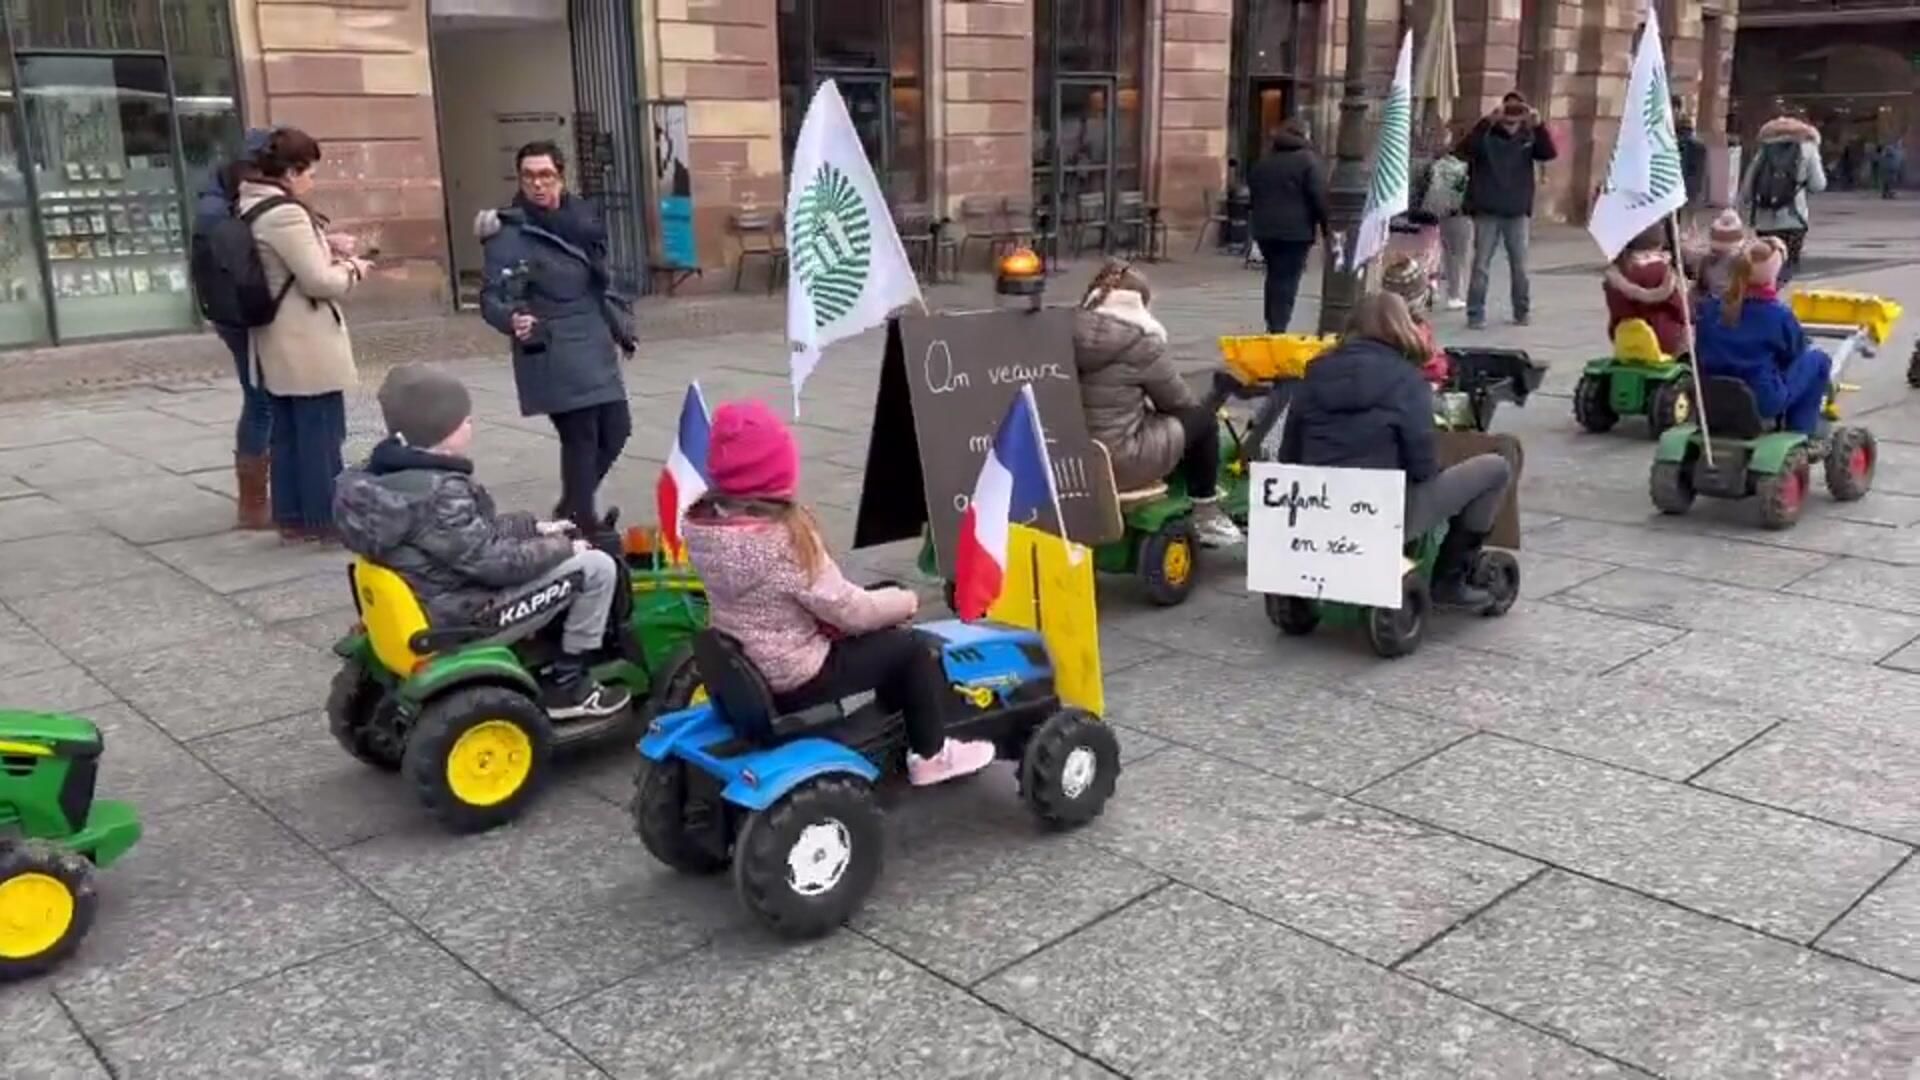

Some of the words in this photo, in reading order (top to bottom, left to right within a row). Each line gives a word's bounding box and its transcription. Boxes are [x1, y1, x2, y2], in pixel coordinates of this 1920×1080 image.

[924, 339, 970, 393] On
[988, 362, 1070, 385] veaux
[1263, 477, 1331, 527] Enfant
[1350, 501, 1378, 515] on
[1291, 537, 1317, 552] en
[499, 580, 571, 626] KAPPA
